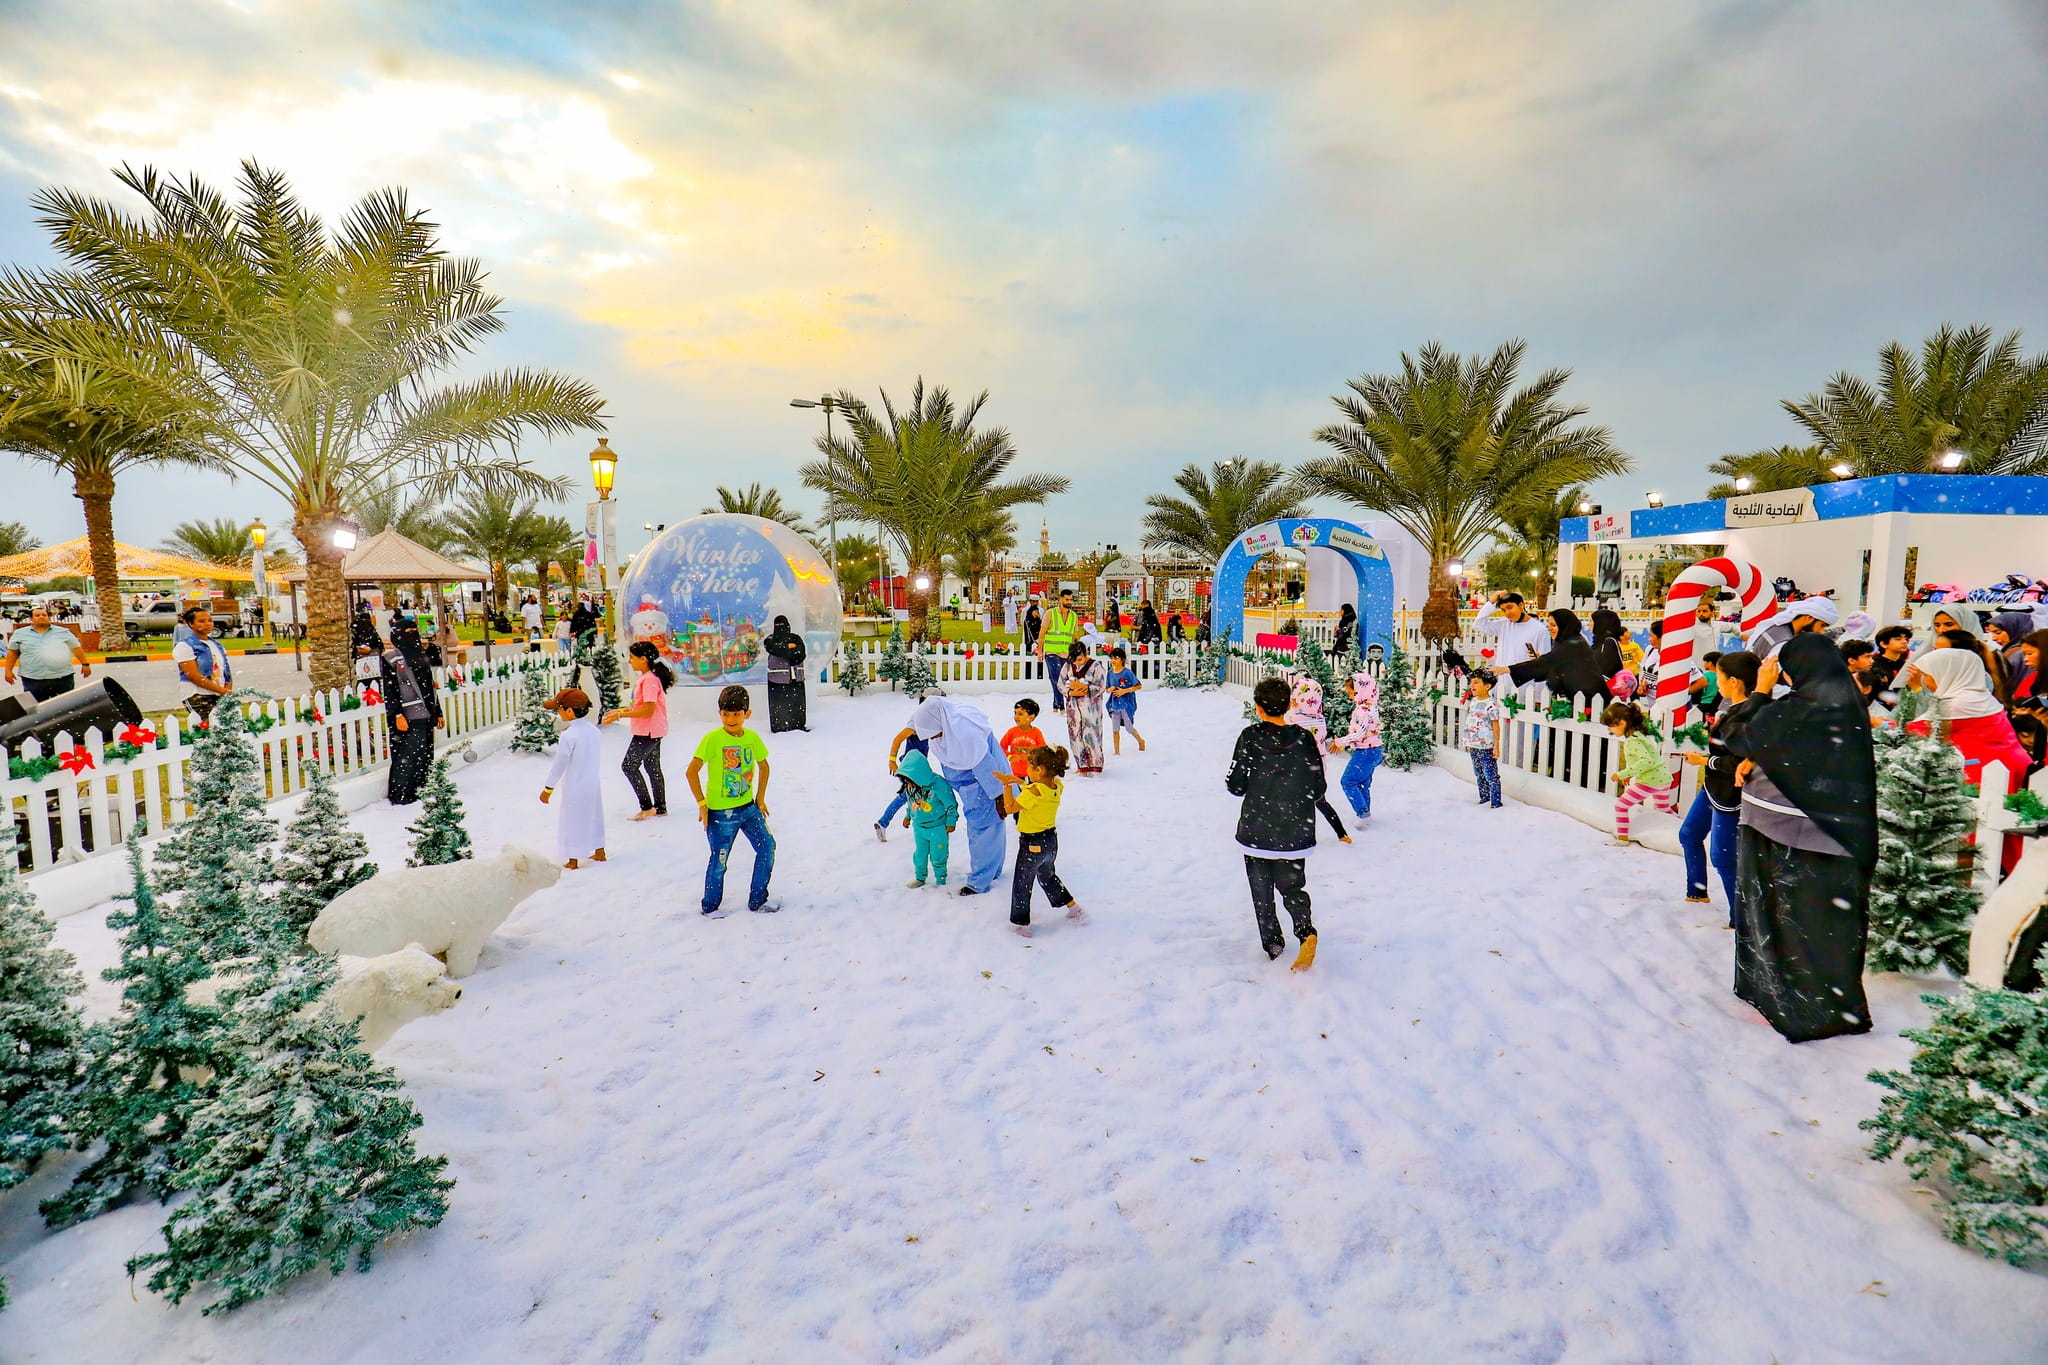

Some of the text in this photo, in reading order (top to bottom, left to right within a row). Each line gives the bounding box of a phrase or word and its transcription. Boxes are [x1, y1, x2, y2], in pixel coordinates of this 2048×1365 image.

[1732, 502, 1804, 519] الضاحية الثلجية
[664, 533, 762, 566] Winter
[671, 566, 760, 595] is here
